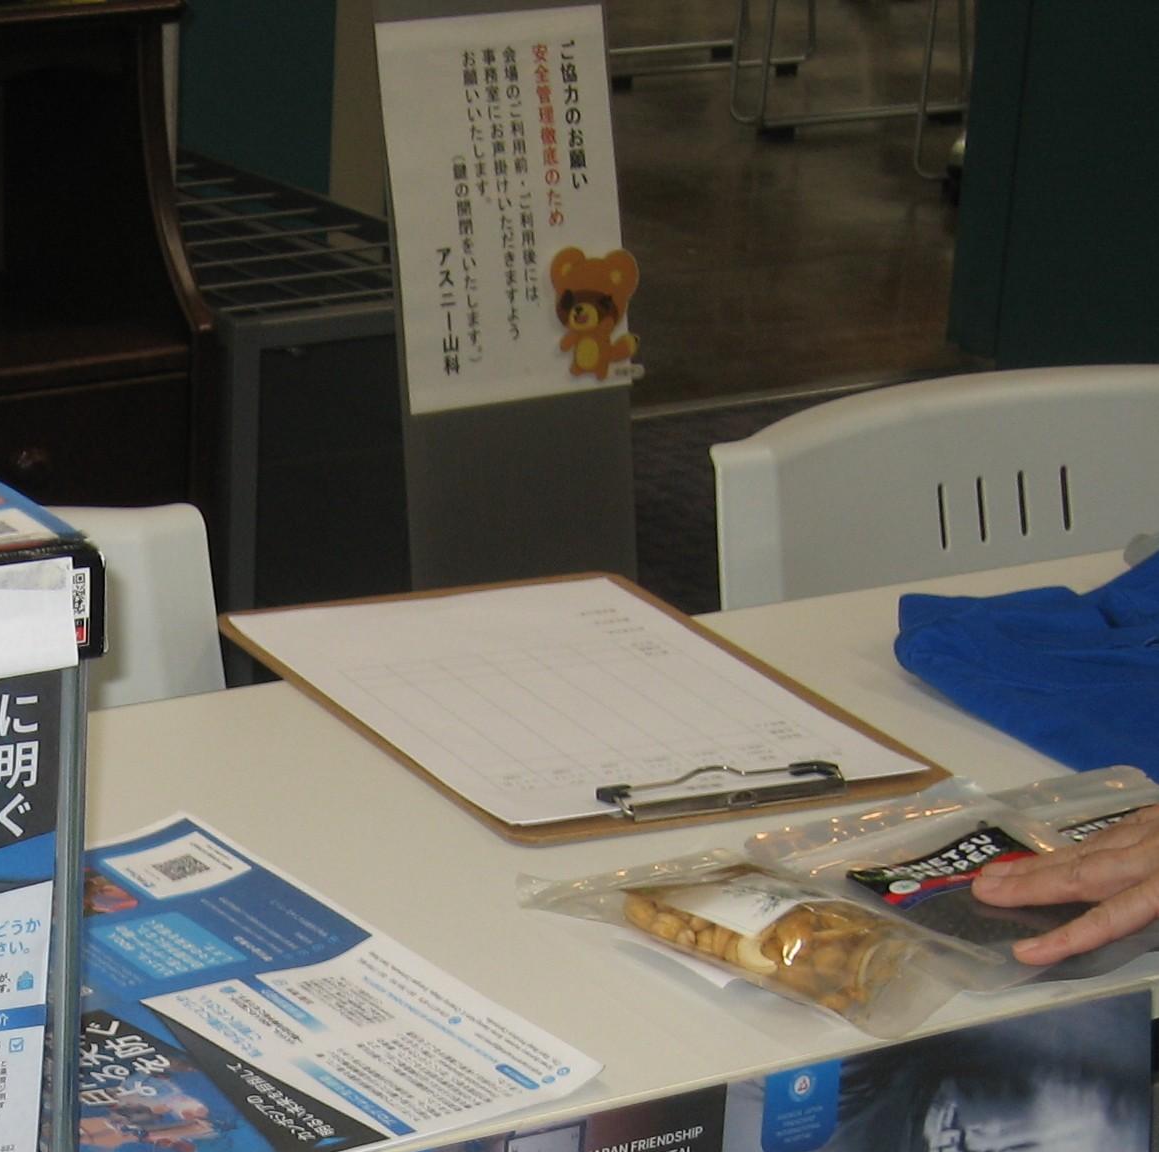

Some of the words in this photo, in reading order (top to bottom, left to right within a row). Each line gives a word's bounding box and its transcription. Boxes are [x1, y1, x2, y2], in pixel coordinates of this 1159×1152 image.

[462, 51, 492, 203] お願いいたします。
[531, 44, 564, 227] 安全管理徹底のため
[560, 41, 588, 190] ご協力のお願い
[482, 48, 522, 340] 事務室にお声掛けいただきますよう
[437, 248, 460, 375] アスニー山科
[85, 1019, 172, 1076] を防ぐ
[226, 1063, 336, 1138] 明るい未来を目指して
[245, 1094, 317, 1144] カンボジアの
[631, 1126, 704, 1152] FRIENDSHIP
